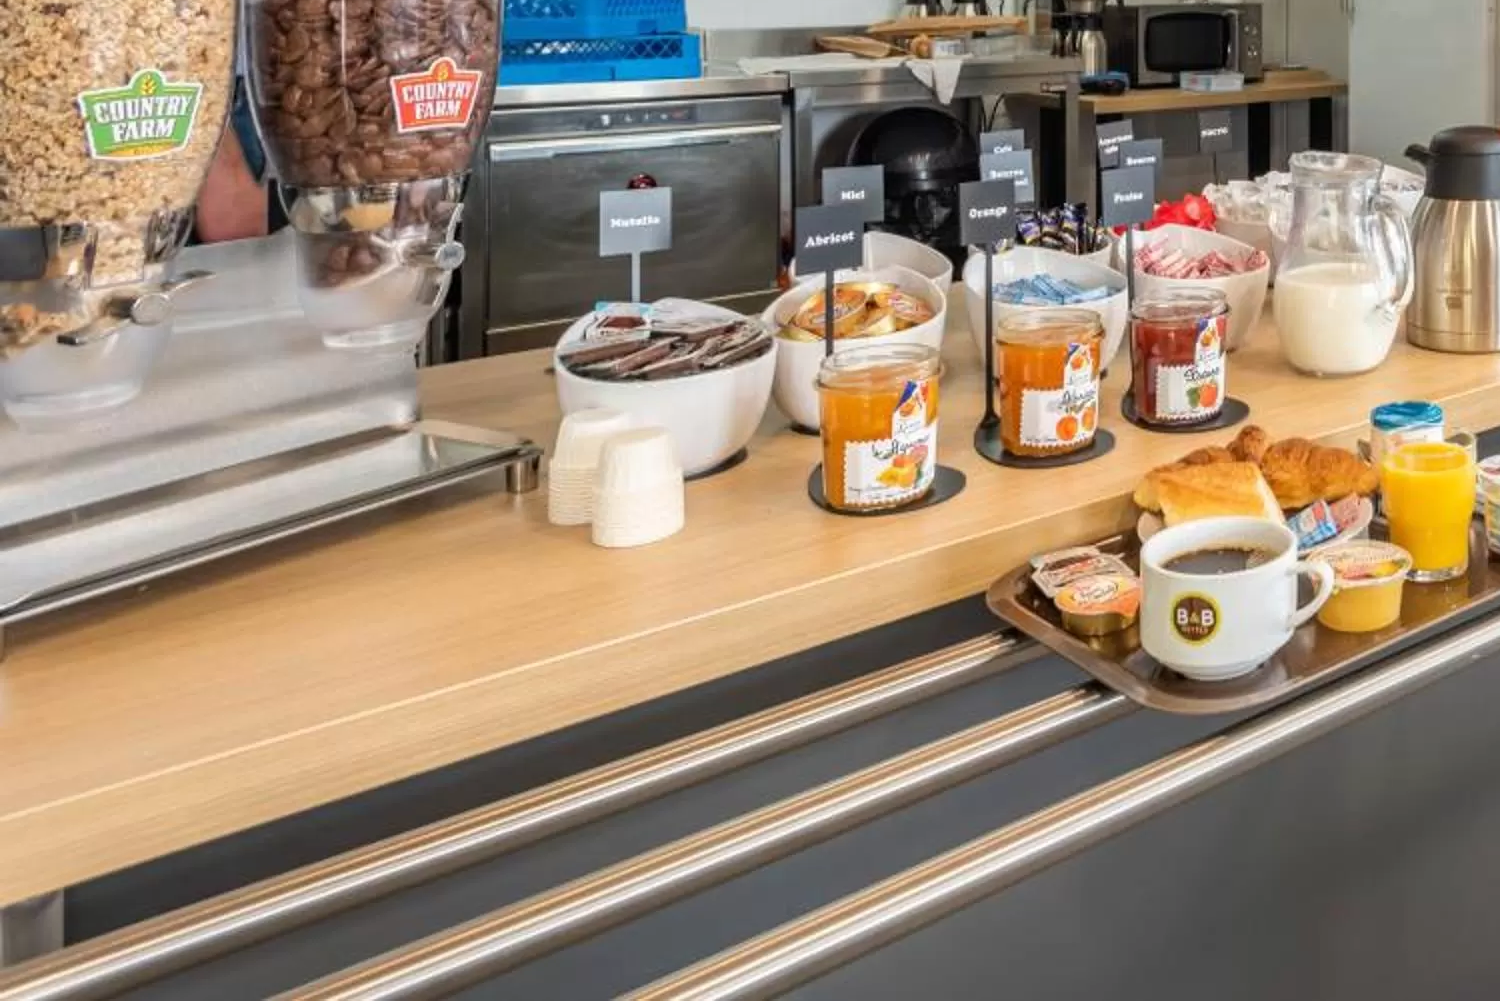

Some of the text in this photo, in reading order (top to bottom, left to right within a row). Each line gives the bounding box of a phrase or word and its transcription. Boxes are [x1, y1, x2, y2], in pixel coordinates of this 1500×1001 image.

[402, 81, 474, 104] COUNTRY
[93, 94, 192, 124] COUNTRY
[415, 99, 462, 120] FARM
[112, 118, 177, 143] FARM
[841, 188, 866, 200] Miel
[967, 205, 1009, 219] Orange
[804, 230, 855, 249] Abricot
[1177, 608, 1214, 626] B&B
